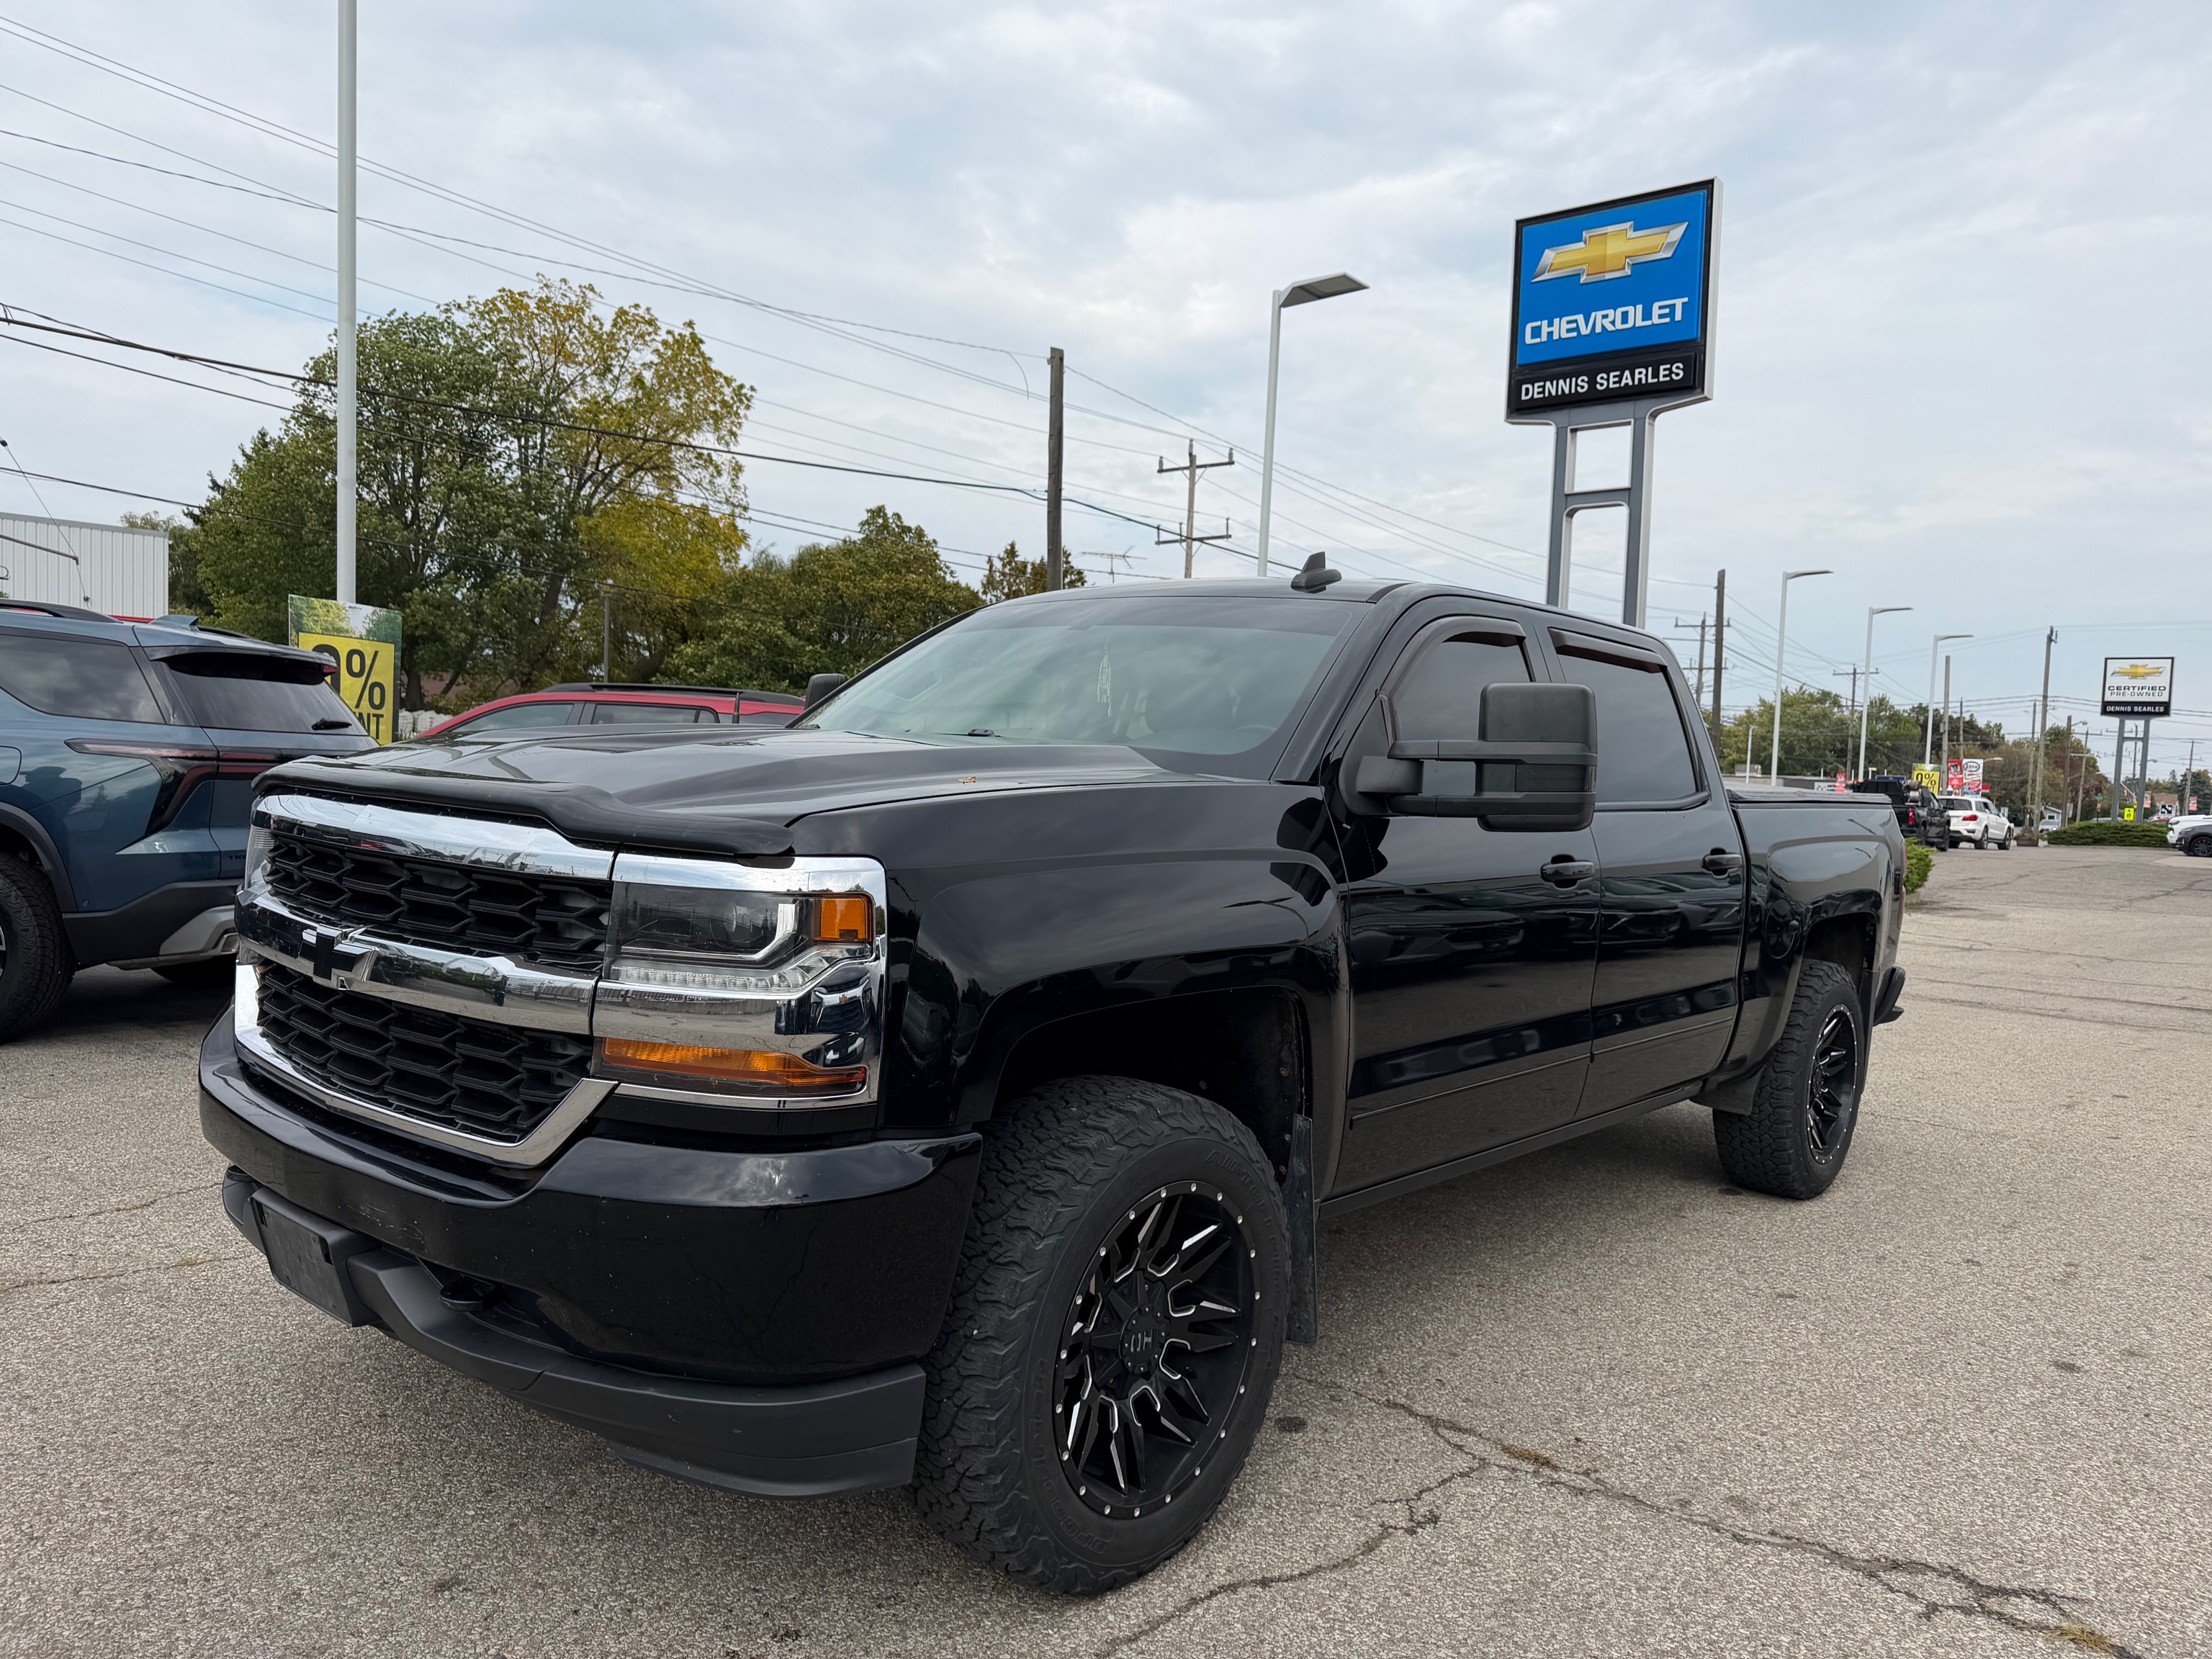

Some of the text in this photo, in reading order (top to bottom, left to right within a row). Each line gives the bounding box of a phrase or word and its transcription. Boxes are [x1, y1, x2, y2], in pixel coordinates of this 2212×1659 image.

[1524, 297, 1689, 345] CHEVROLET
[1521, 362, 1684, 400] DENNIS SEARLES
